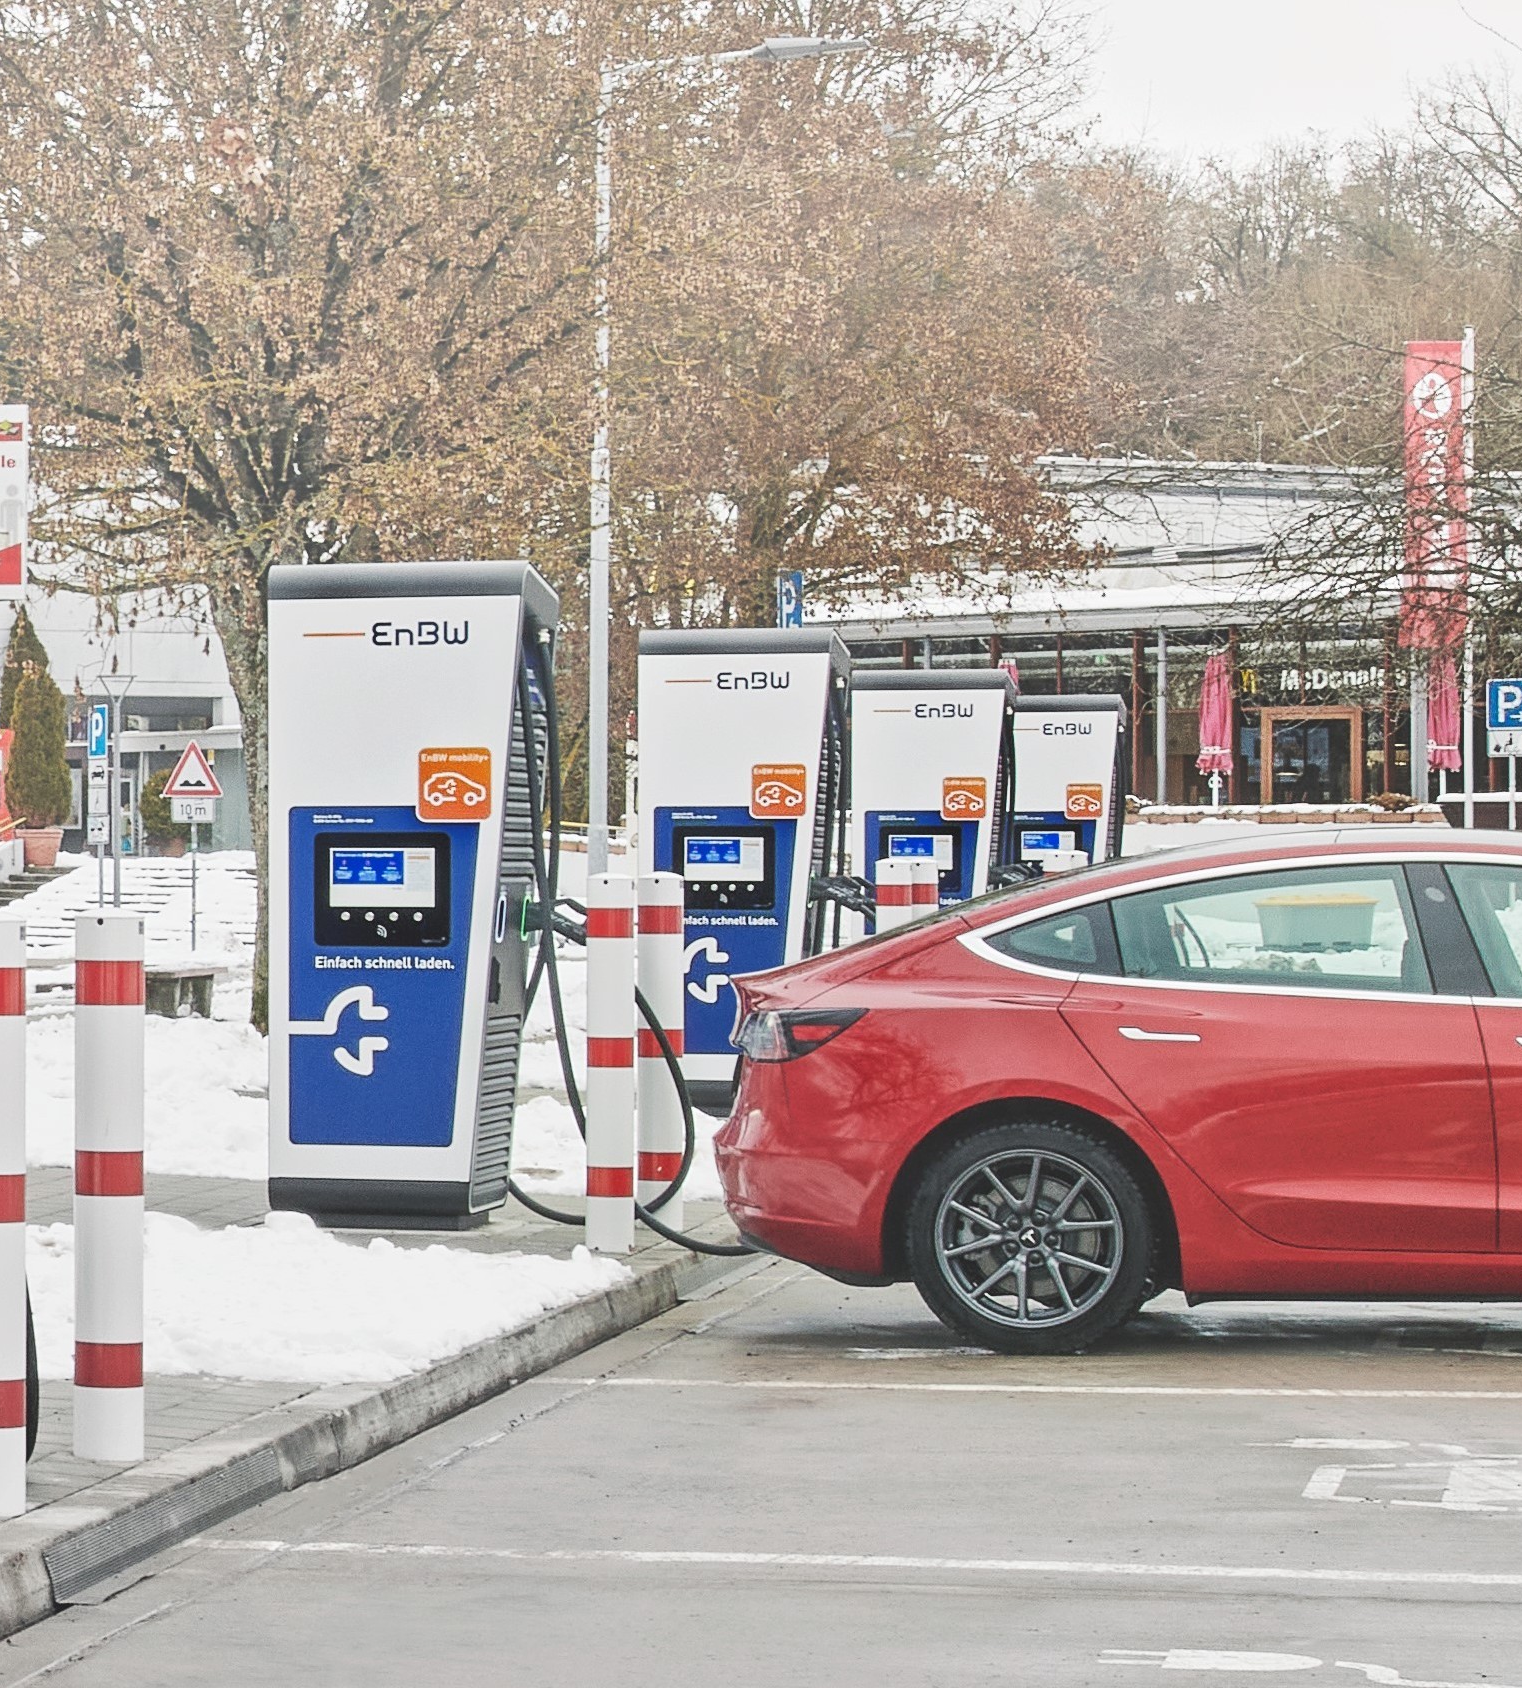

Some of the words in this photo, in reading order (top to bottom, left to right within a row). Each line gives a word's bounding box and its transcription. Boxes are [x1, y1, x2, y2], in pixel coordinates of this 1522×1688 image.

[372, 621, 469, 646] EnBW
[716, 671, 790, 690] EnBW
[914, 703, 973, 719] EnBW
[1497, 685, 1522, 723] P
[91, 712, 103, 752] P
[1042, 722, 1092, 736] EnBW
[180, 804, 192, 816] 10
[194, 806, 206, 816] m
[711, 916, 746, 926] schnell
[747, 916, 778, 926] laden.
[314, 956, 362, 970] Einfach
[365, 956, 412, 970] schnell
[415, 956, 456, 970] laden.
